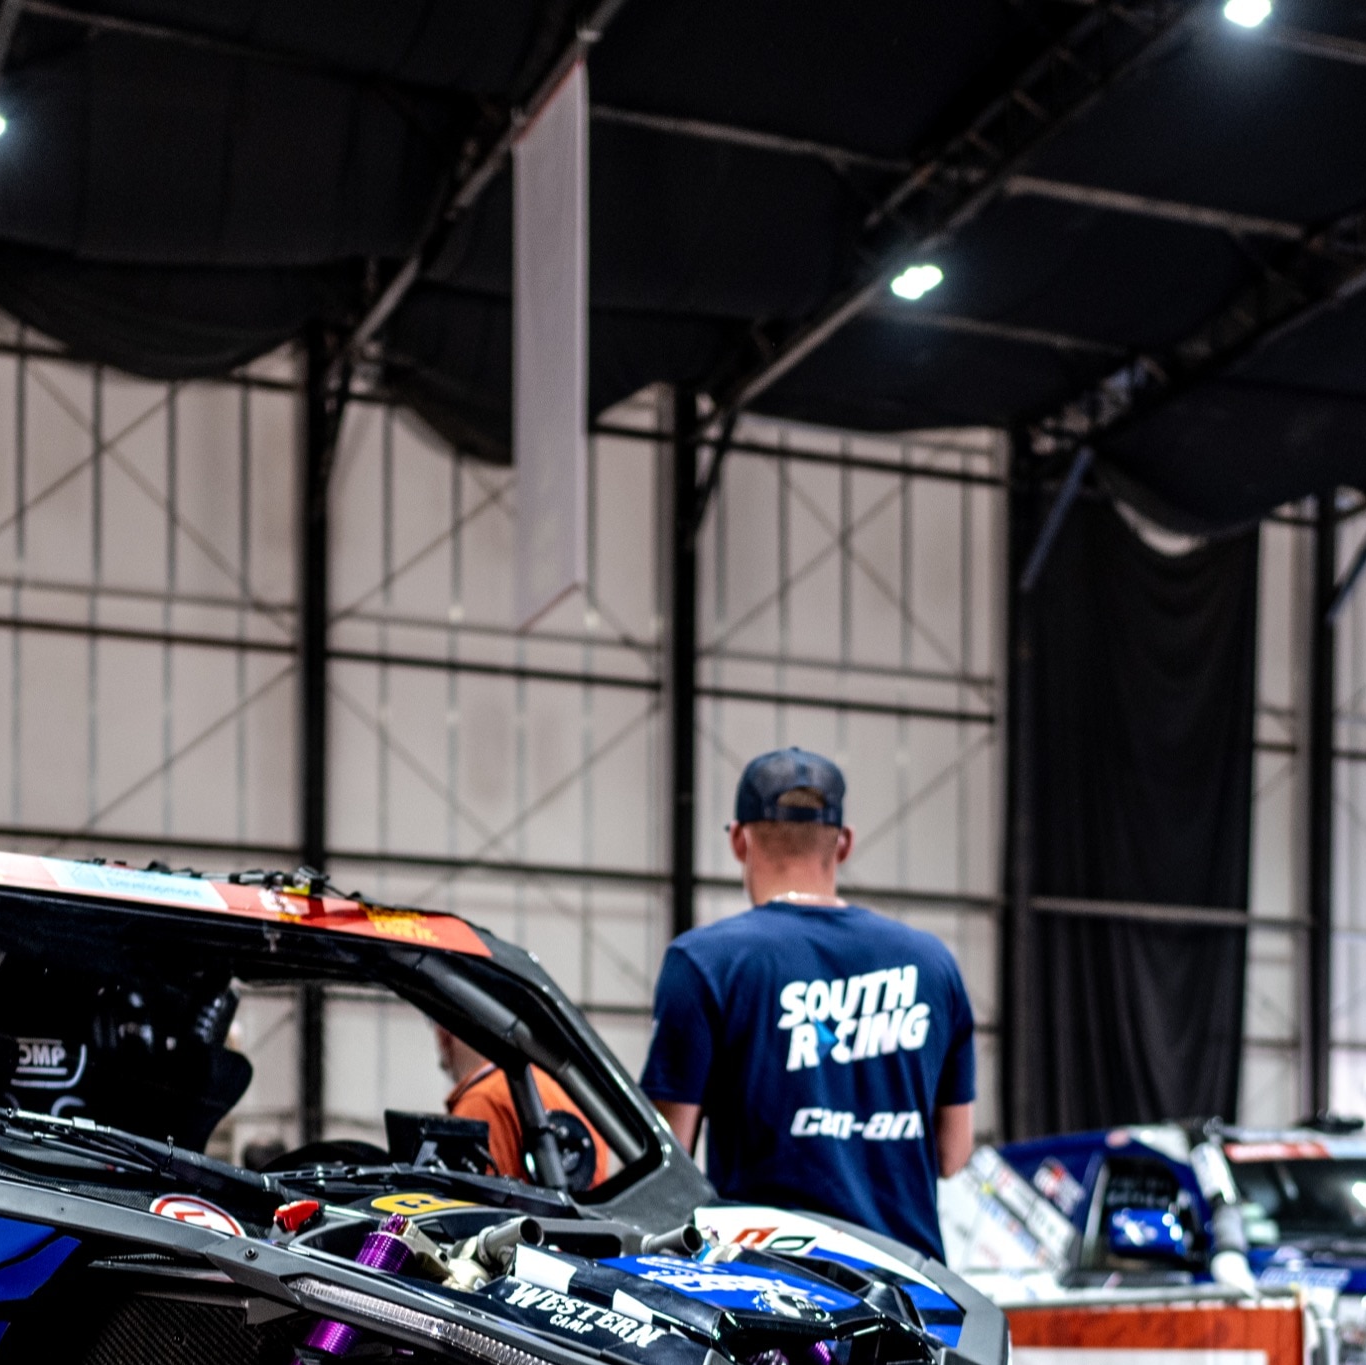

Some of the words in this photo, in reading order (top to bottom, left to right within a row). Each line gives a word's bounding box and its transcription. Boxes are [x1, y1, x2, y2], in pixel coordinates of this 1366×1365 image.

[777, 965, 918, 1029] SOUTH
[504, 1276, 670, 1349] WESTERN
[550, 1314, 595, 1336] CAMP
